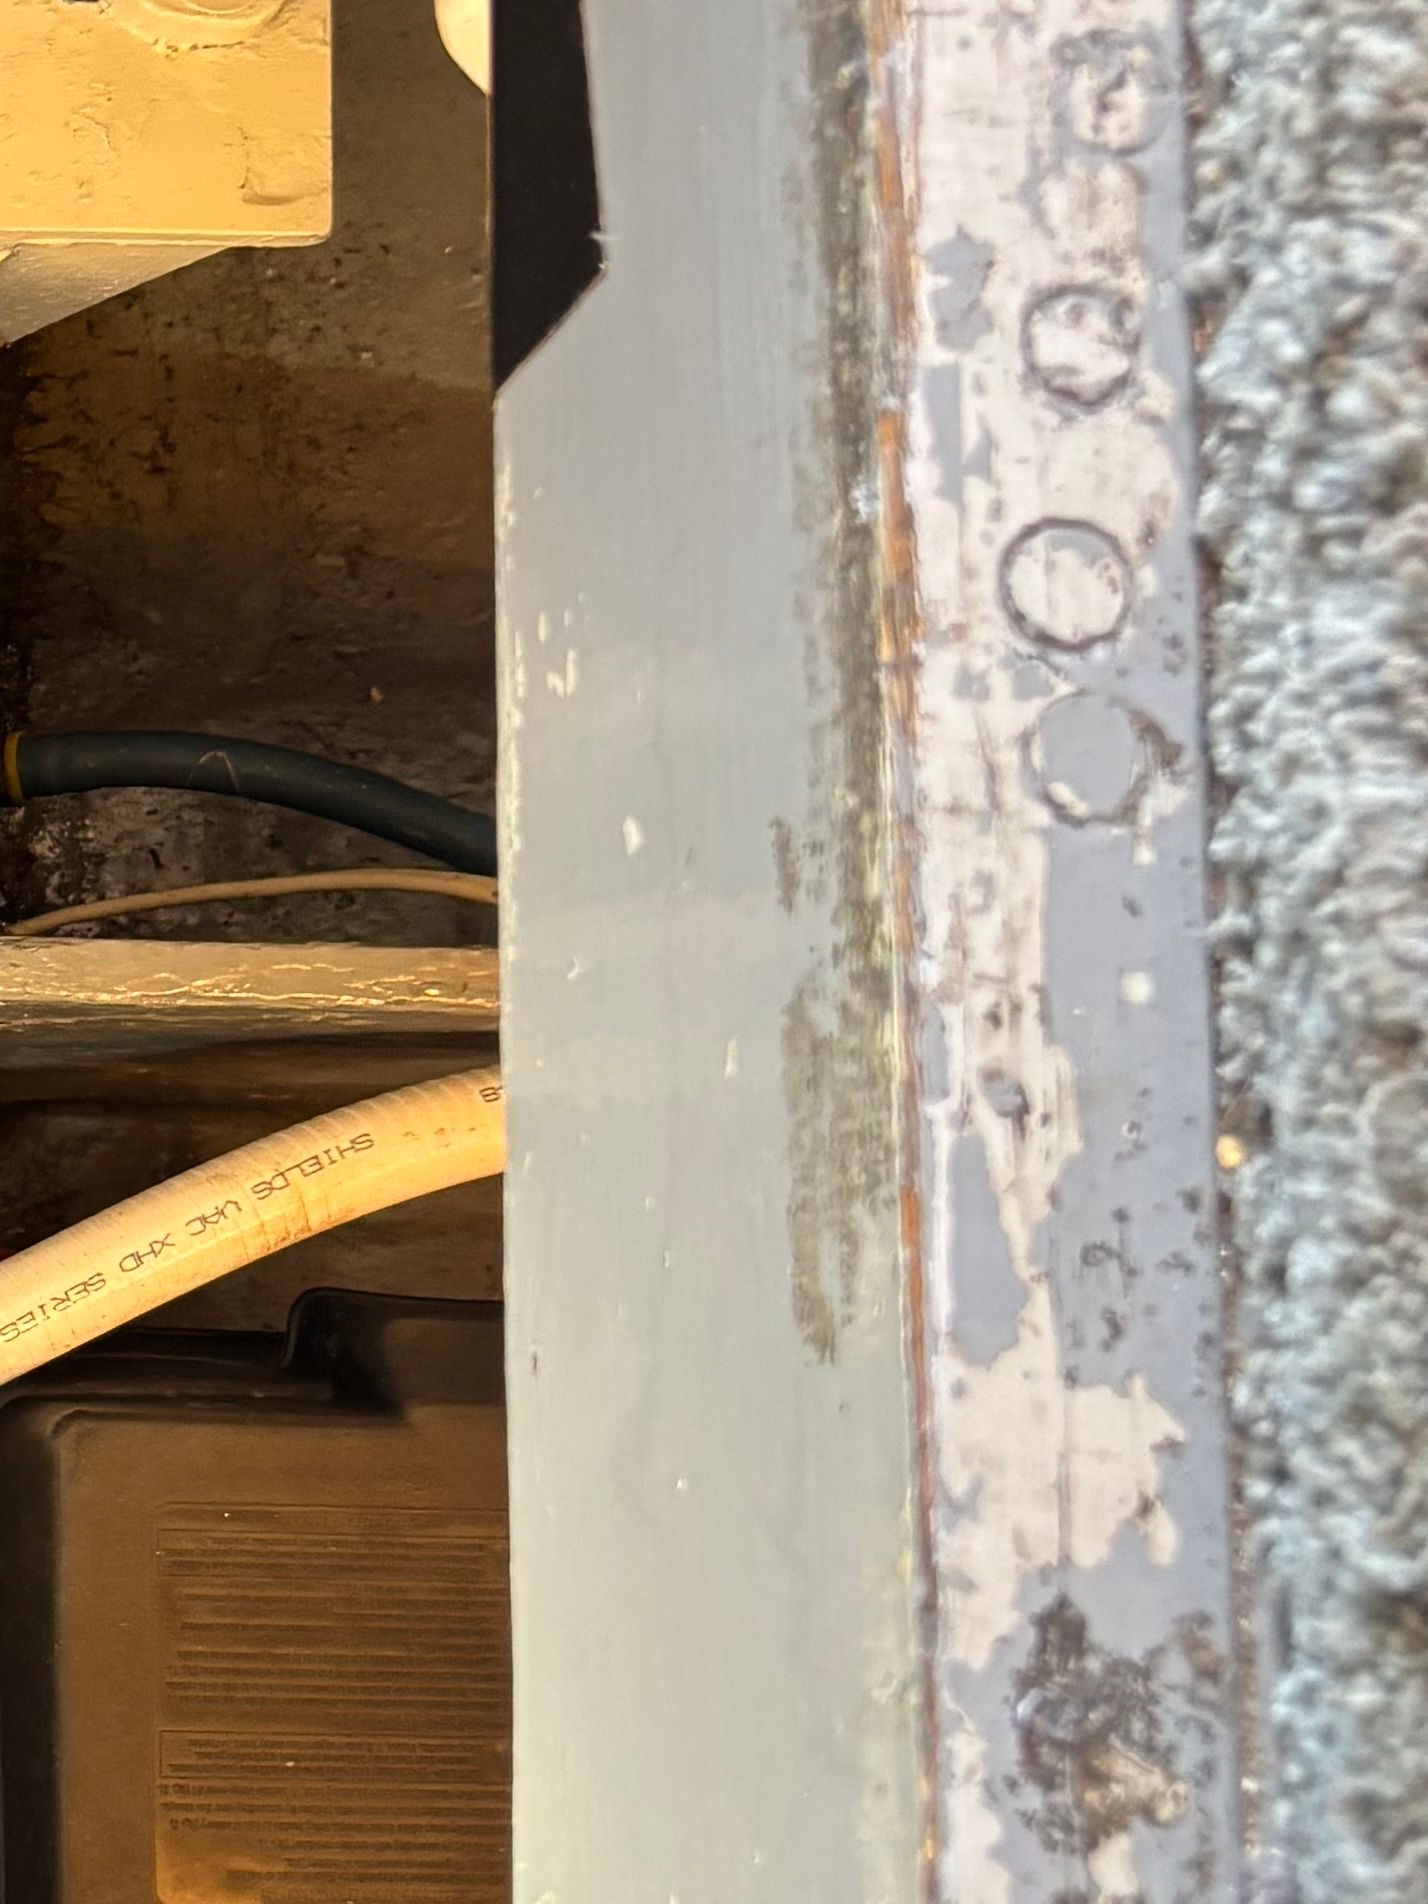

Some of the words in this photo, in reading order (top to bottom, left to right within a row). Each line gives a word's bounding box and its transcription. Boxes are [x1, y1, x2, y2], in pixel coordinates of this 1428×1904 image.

[250, 1129, 373, 1202] SHIELDS
[184, 1196, 242, 1237] VAC
[119, 1230, 176, 1276] XHD
